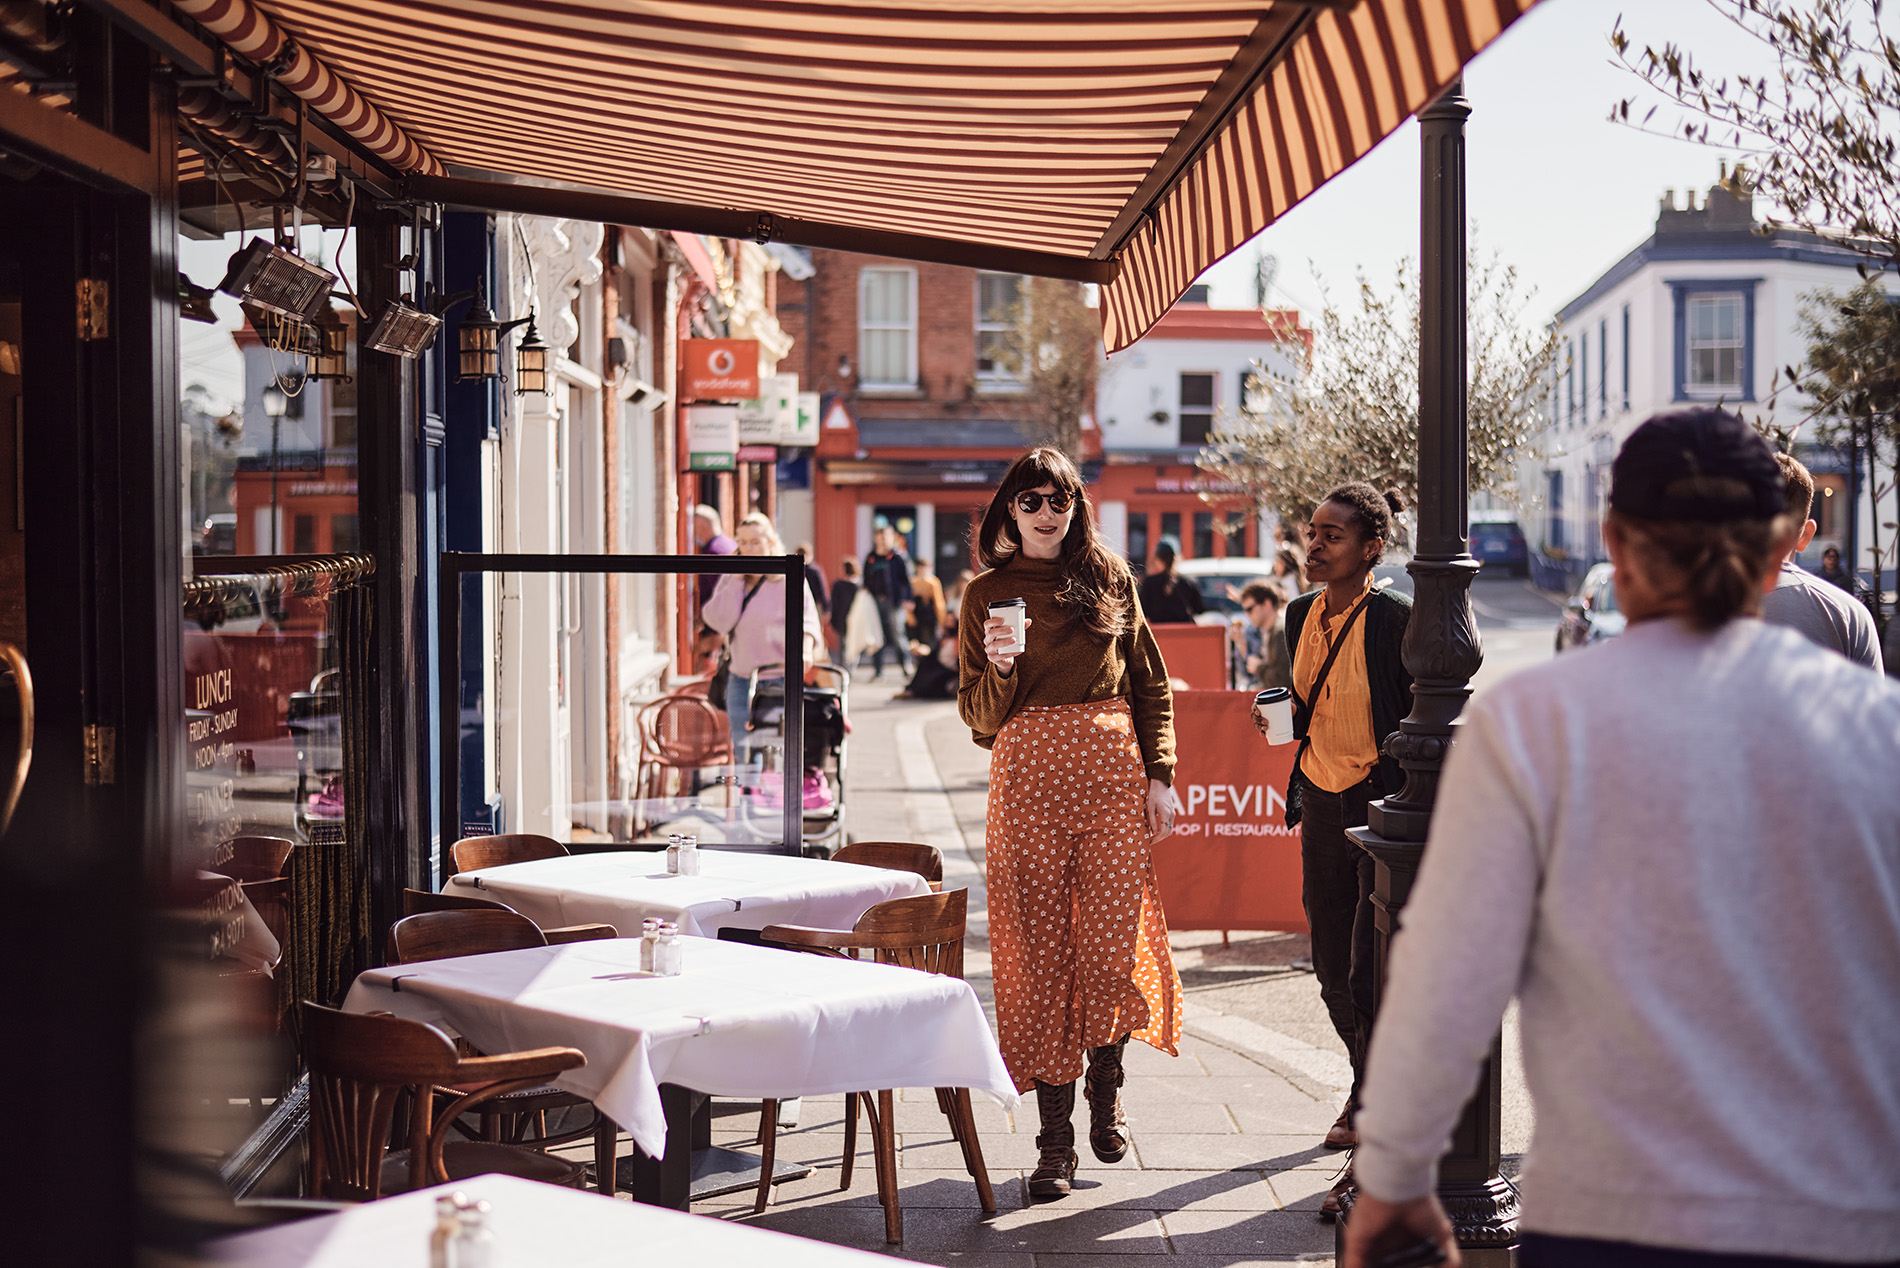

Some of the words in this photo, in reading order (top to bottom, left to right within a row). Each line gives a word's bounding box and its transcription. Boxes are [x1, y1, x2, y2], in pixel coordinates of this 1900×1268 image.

[196, 668, 232, 709] LUNCH
[189, 717, 211, 742] FRIDAY
[214, 708, 239, 734] SUNDAY
[195, 743, 217, 770] NOON
[221, 740, 234, 763] 4pm
[196, 779, 235, 825] DINNER
[1214, 823, 1301, 838] RESTAURANT
[215, 840, 235, 867] CLOSE
